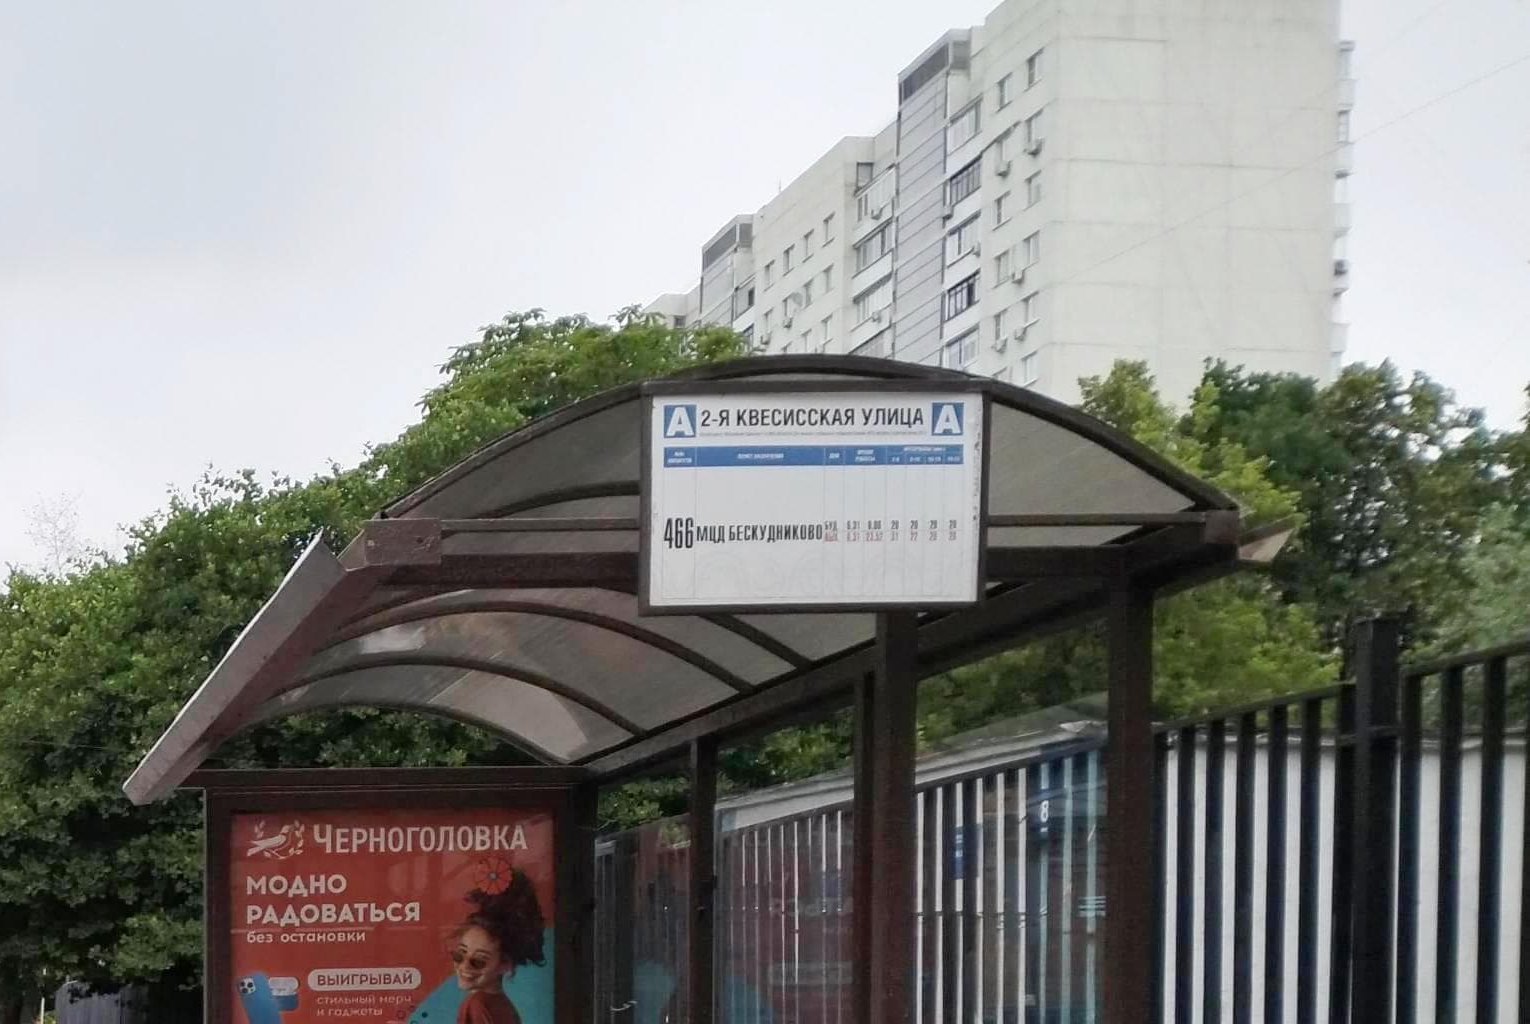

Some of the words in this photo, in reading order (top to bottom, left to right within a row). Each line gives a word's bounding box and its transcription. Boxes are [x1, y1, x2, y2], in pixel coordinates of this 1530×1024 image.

[700, 409, 730, 427] 2-Я
[736, 408, 856, 427] КВЕСИССКАЯ
[862, 407, 925, 429] УЛИЦА
[663, 517, 695, 549] 466
[696, 527, 726, 545] МЦД
[728, 522, 823, 543] БЕСКУДНИКОВО
[313, 823, 528, 854] ЧЕРНОГОЛОВКА
[246, 874, 348, 898] МОДНО
[246, 902, 421, 927] РАДОВАТЬСЯ
[246, 931, 274, 944] без
[280, 931, 366, 943] остановки
[317, 970, 413, 986] ВЫИГРЫВАЙ
[316, 994, 376, 1005] стильный
[379, 995, 412, 1006] мерч
[328, 1007, 383, 1018] гаджеты
